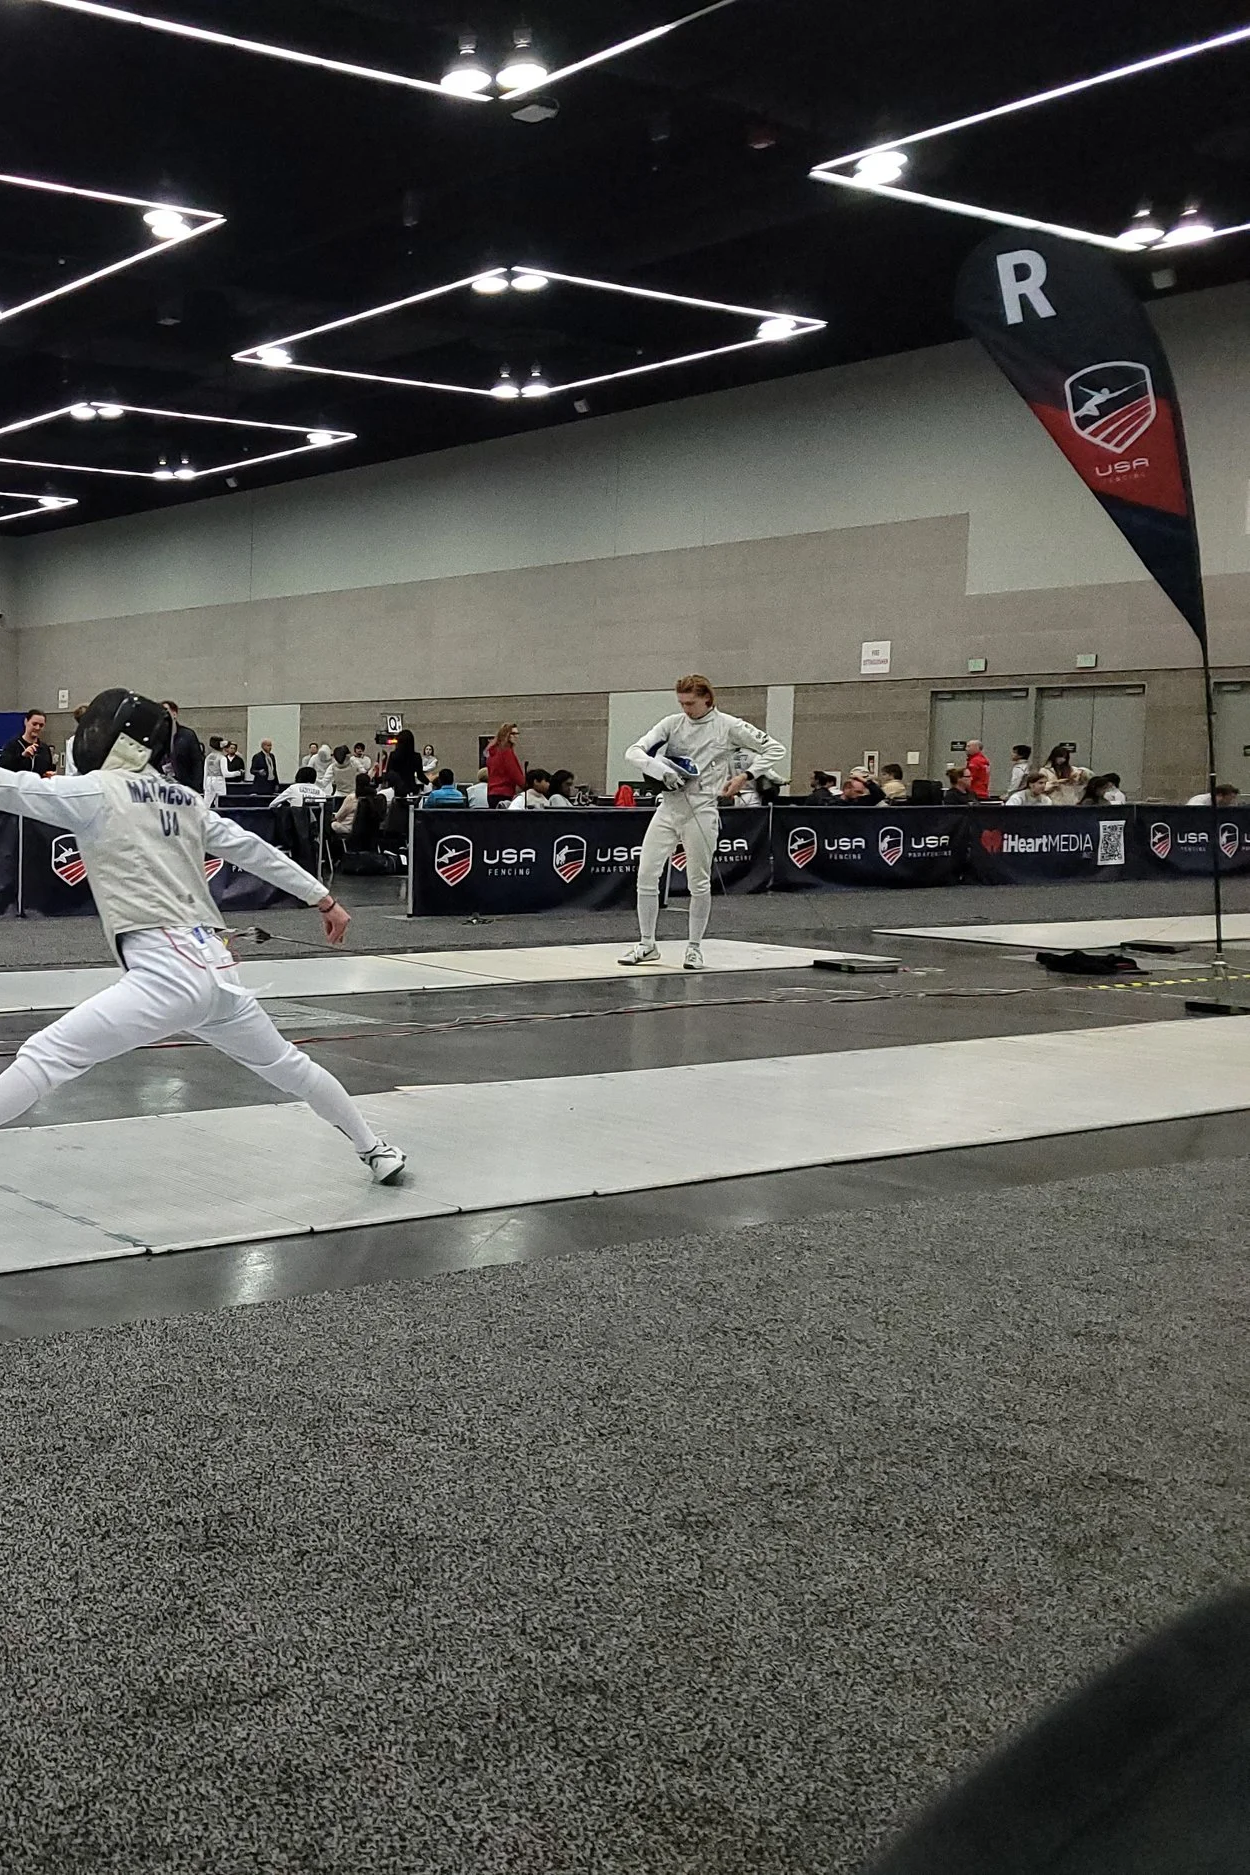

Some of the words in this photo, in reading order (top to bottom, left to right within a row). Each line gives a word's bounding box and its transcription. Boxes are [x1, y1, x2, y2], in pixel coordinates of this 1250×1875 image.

[996, 250, 1057, 325] R
[1095, 457, 1150, 477] USA
[388, 716, 398, 731] Q
[824, 838, 866, 850] USA
[910, 835, 950, 849] USA
[1002, 833, 1093, 853] iHeartMEDIA
[1177, 832, 1209, 843] USA
[718, 838, 749, 852] SA
[483, 848, 536, 864] USA
[596, 846, 642, 862] USA
[488, 868, 531, 876] FENCING
[590, 865, 638, 874] PARAFENC
